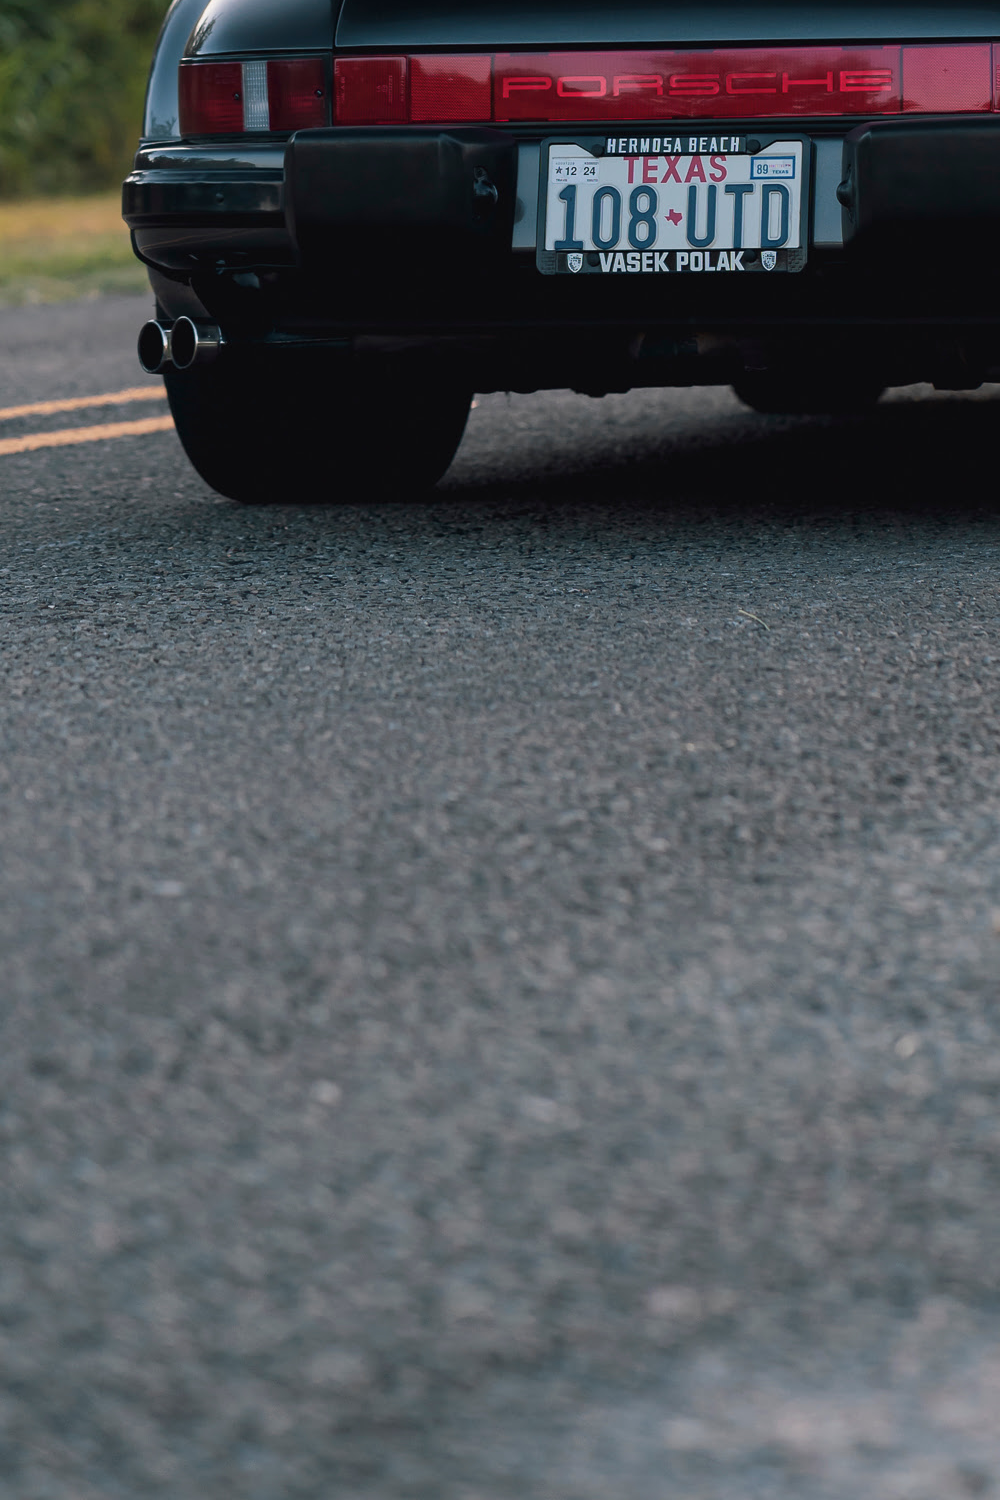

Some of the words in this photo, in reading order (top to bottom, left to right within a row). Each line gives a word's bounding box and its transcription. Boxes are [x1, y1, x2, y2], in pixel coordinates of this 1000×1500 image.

[502, 70, 892, 98] PORSCHE
[607, 138, 682, 153] HERMOSA
[688, 137, 740, 153] BEACH
[565, 166, 577, 176] 12
[583, 166, 596, 176] 24
[623, 155, 727, 184] TEXAS
[756, 164, 769, 174] 89
[554, 184, 658, 250] 108
[686, 183, 790, 249] UTD
[599, 251, 669, 272] VASEK
[676, 251, 745, 272] POLAK
